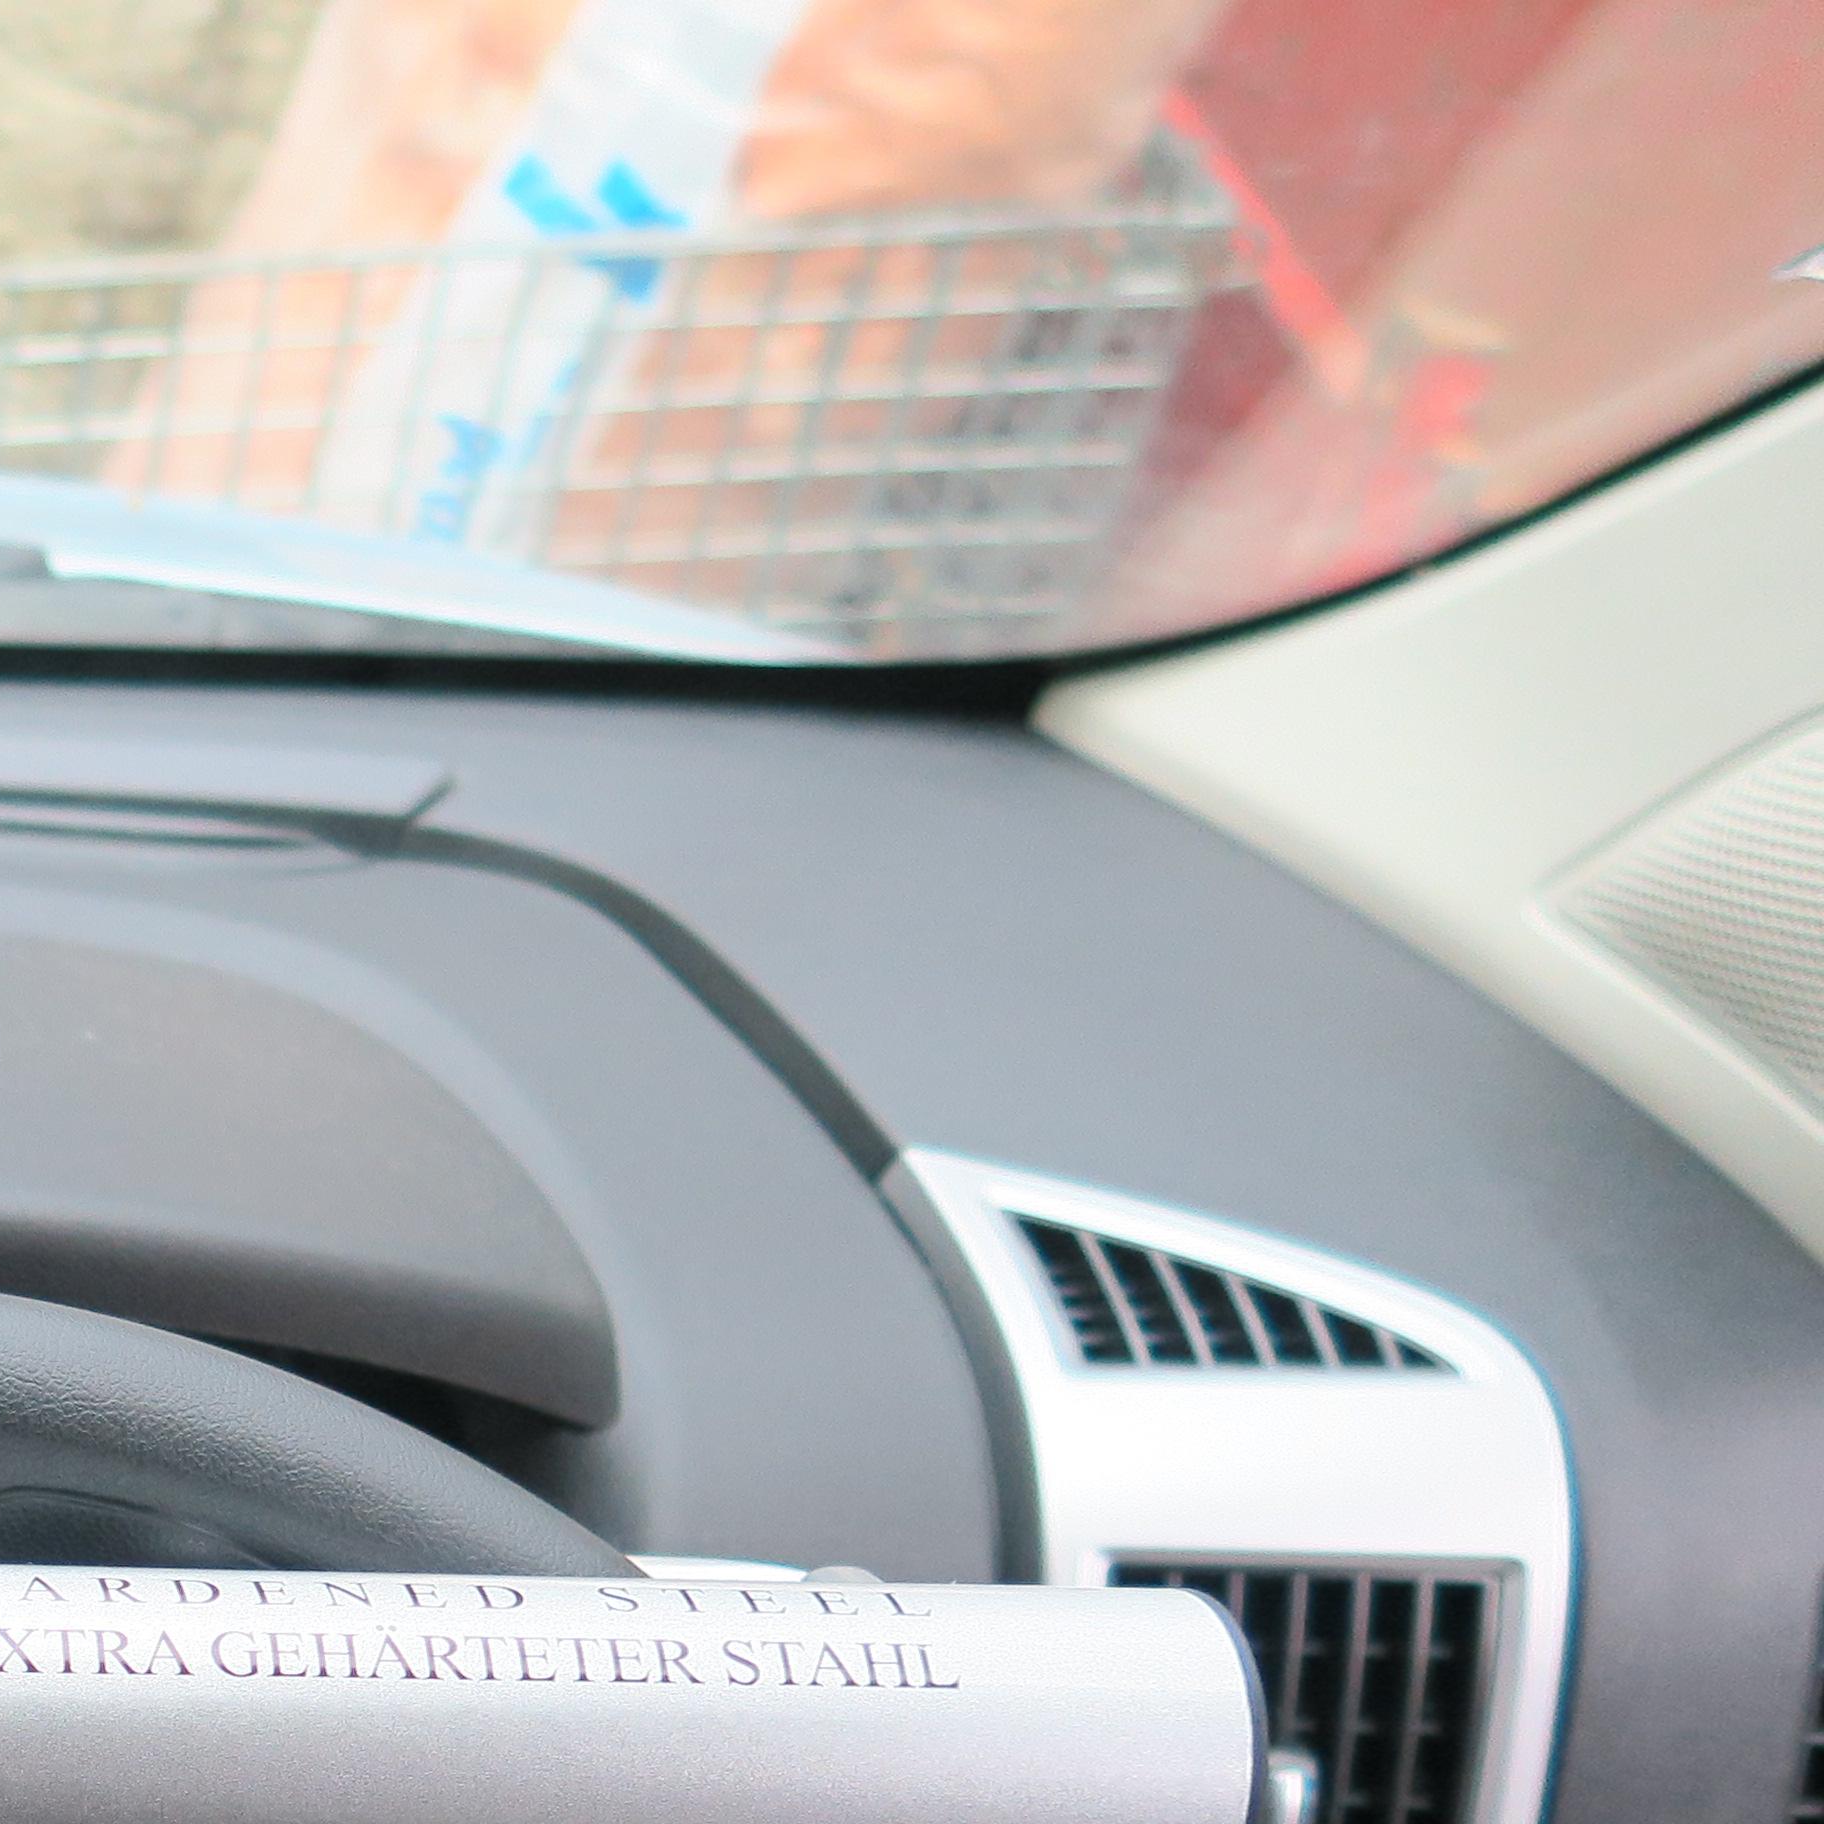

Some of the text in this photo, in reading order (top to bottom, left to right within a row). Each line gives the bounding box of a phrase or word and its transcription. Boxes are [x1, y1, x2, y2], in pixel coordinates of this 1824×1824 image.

[597, 1586, 933, 1617] STEEL
[210, 1624, 705, 1685] GEHÄRTETER
[722, 1639, 961, 1690] STAHL
